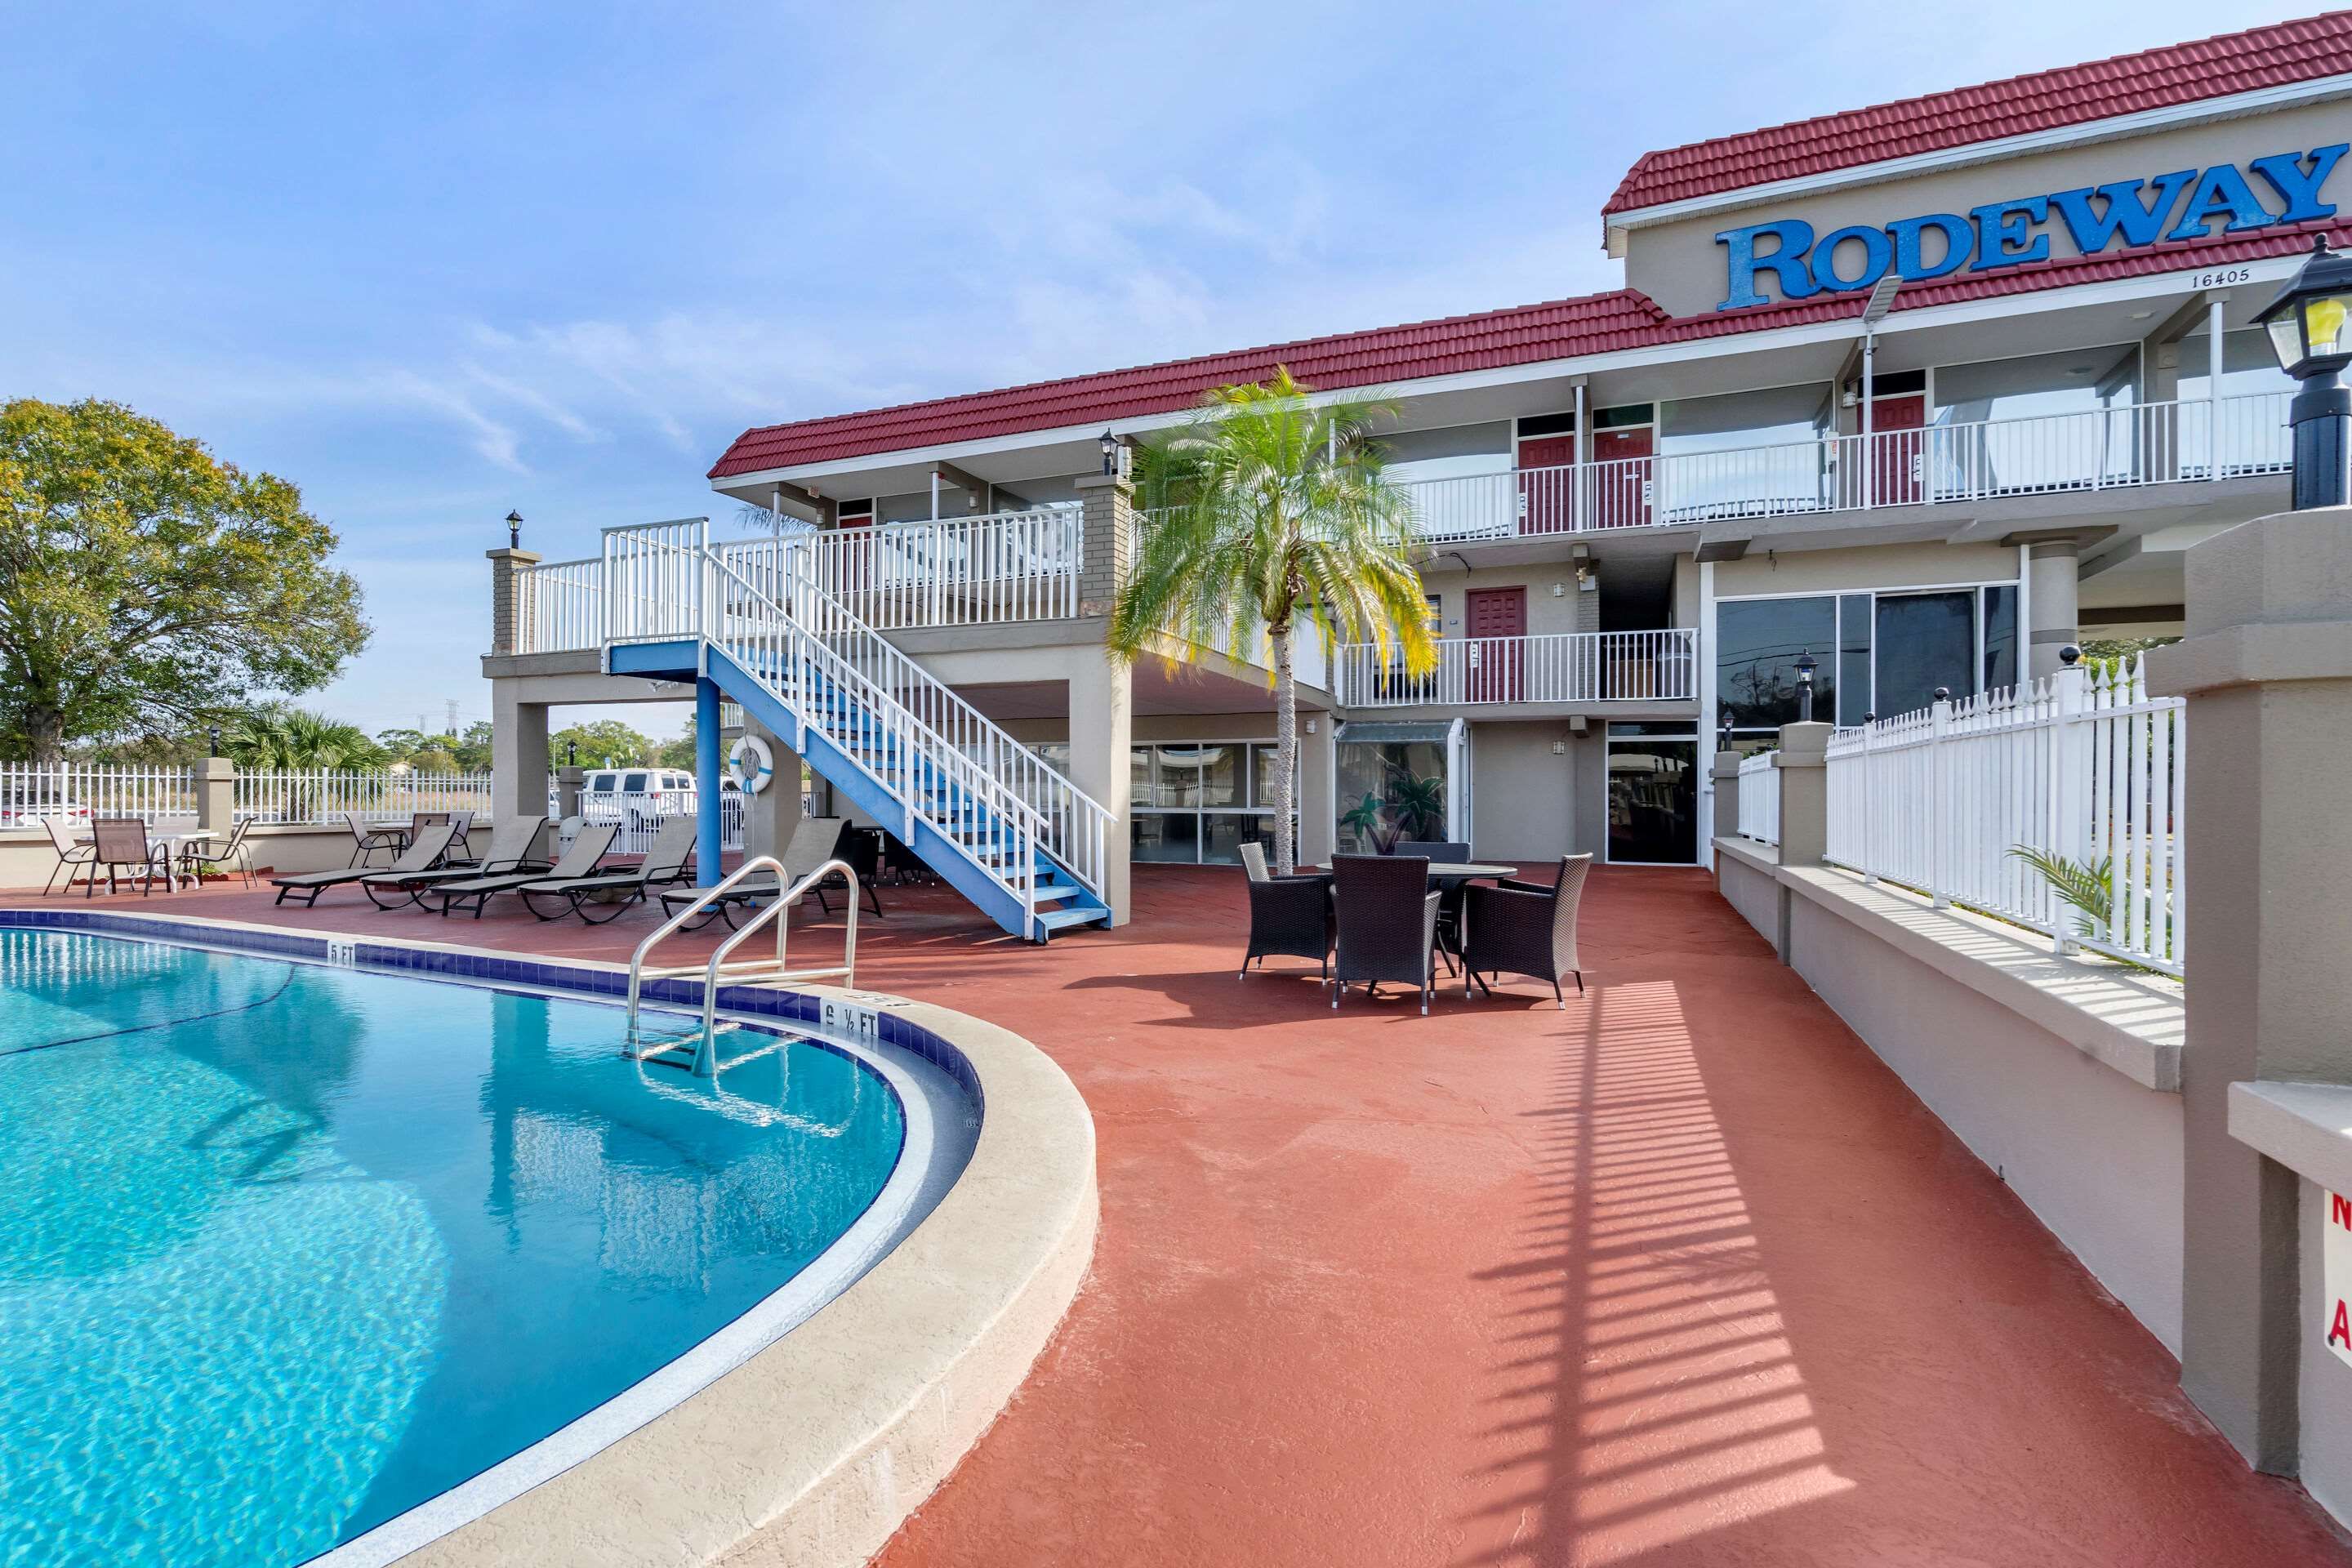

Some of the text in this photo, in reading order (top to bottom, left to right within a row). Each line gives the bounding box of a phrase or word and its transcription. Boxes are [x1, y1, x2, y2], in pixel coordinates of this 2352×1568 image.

[1715, 143, 2351, 311] RODEWAY
[2193, 269, 2249, 288] 16405
[332, 944, 354, 962] 5 FT
[826, 1004, 835, 1025] 6
[860, 1012, 876, 1036] FT
